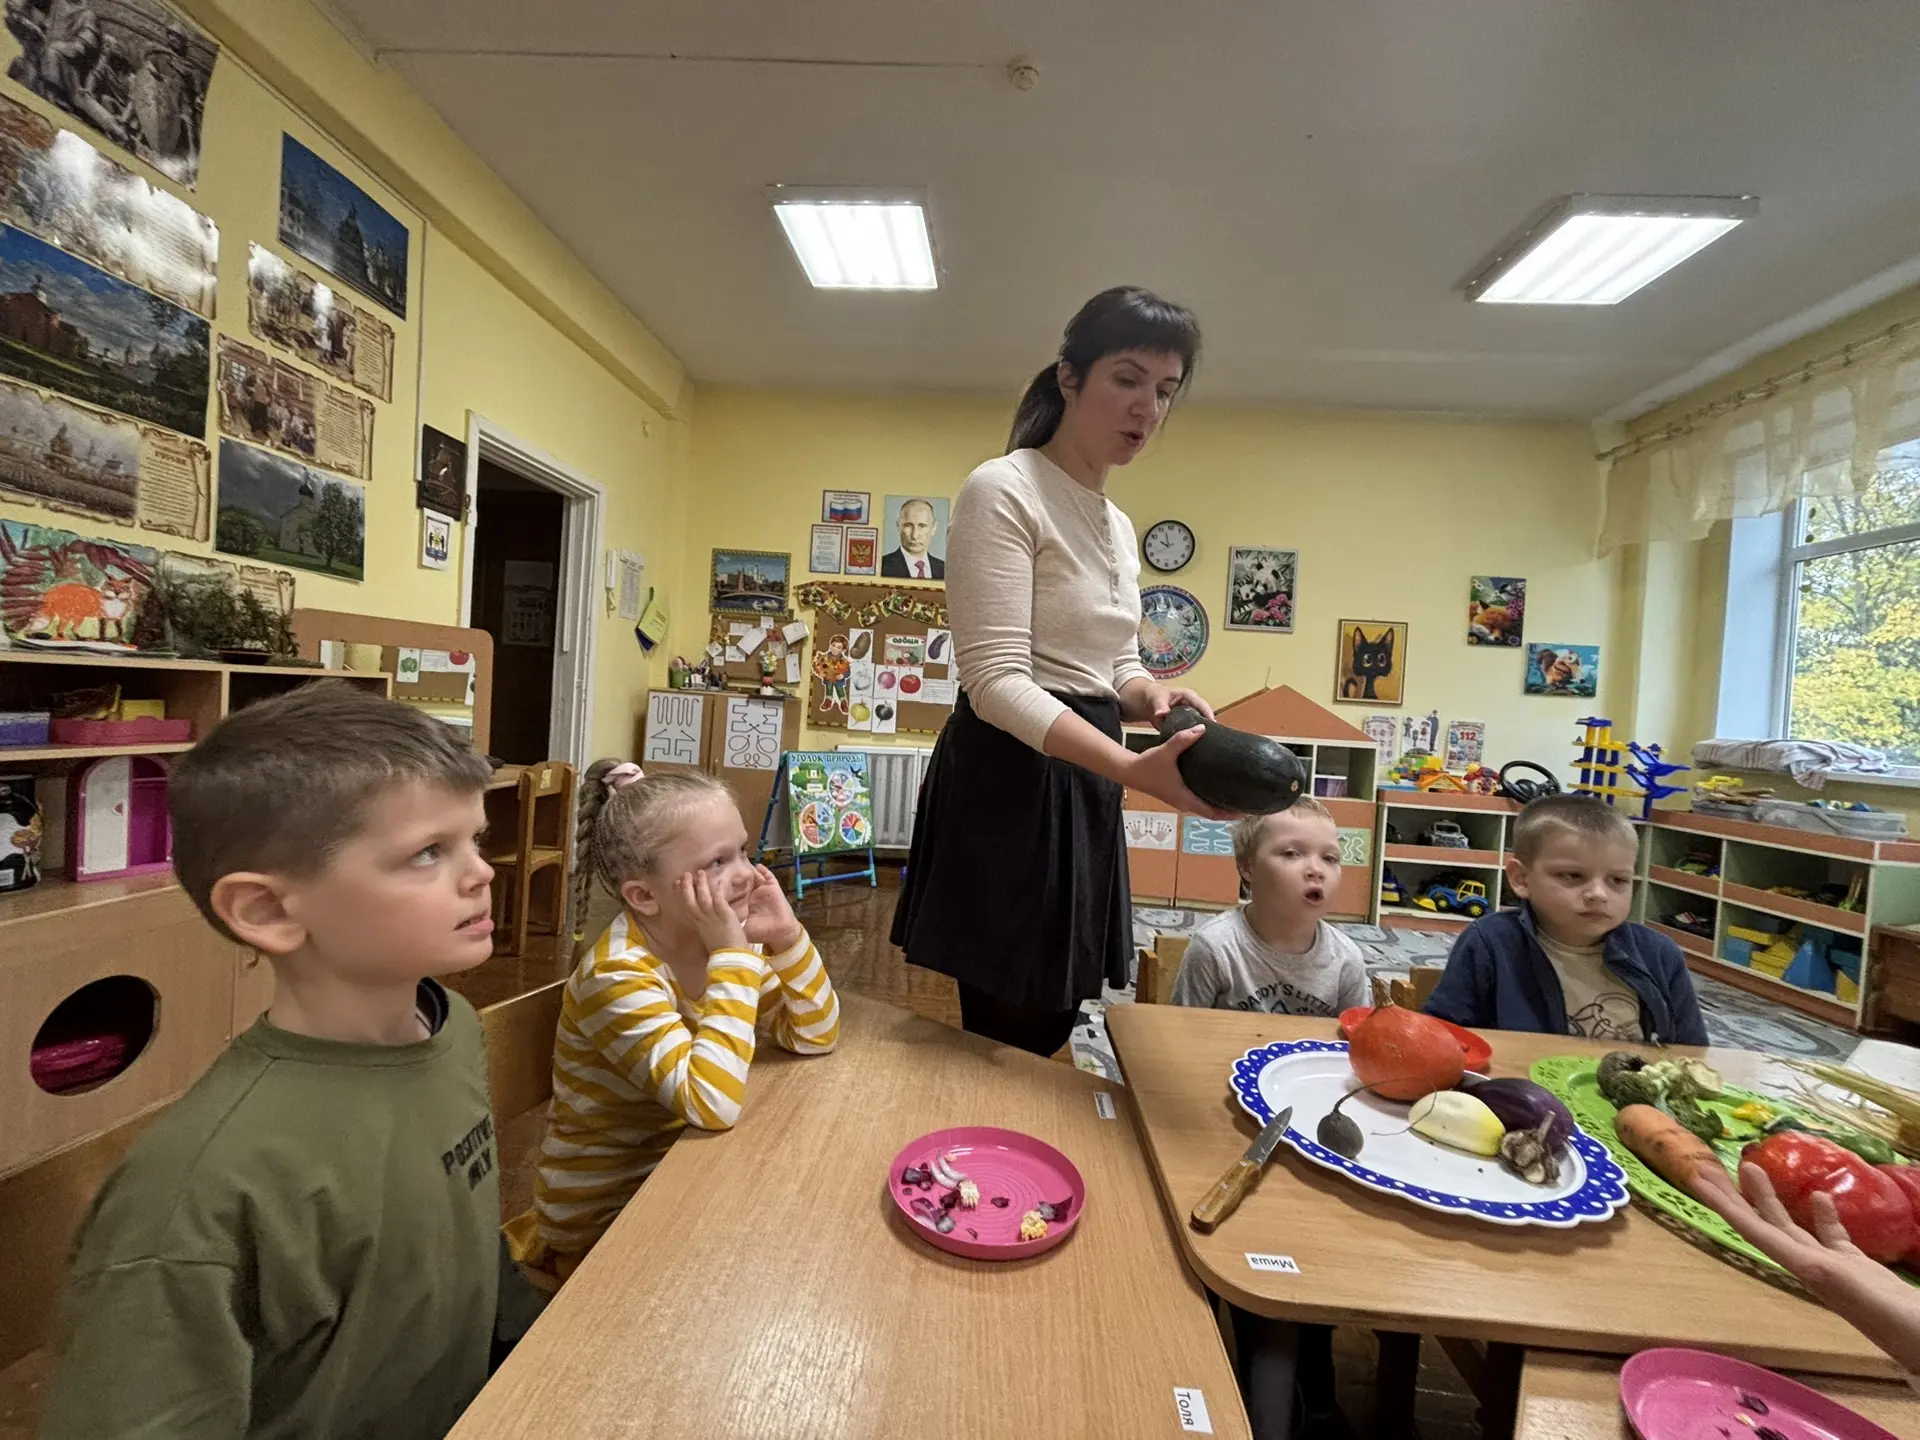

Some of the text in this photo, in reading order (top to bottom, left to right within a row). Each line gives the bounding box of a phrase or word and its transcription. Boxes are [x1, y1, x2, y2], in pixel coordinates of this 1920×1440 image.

[1460, 731, 1476, 740] 112
[791, 753, 864, 763] УГОЛОК ПРИРОДЫ
[1250, 1257, 1294, 1269] Миша
[1177, 1391, 1195, 1426] Толя
